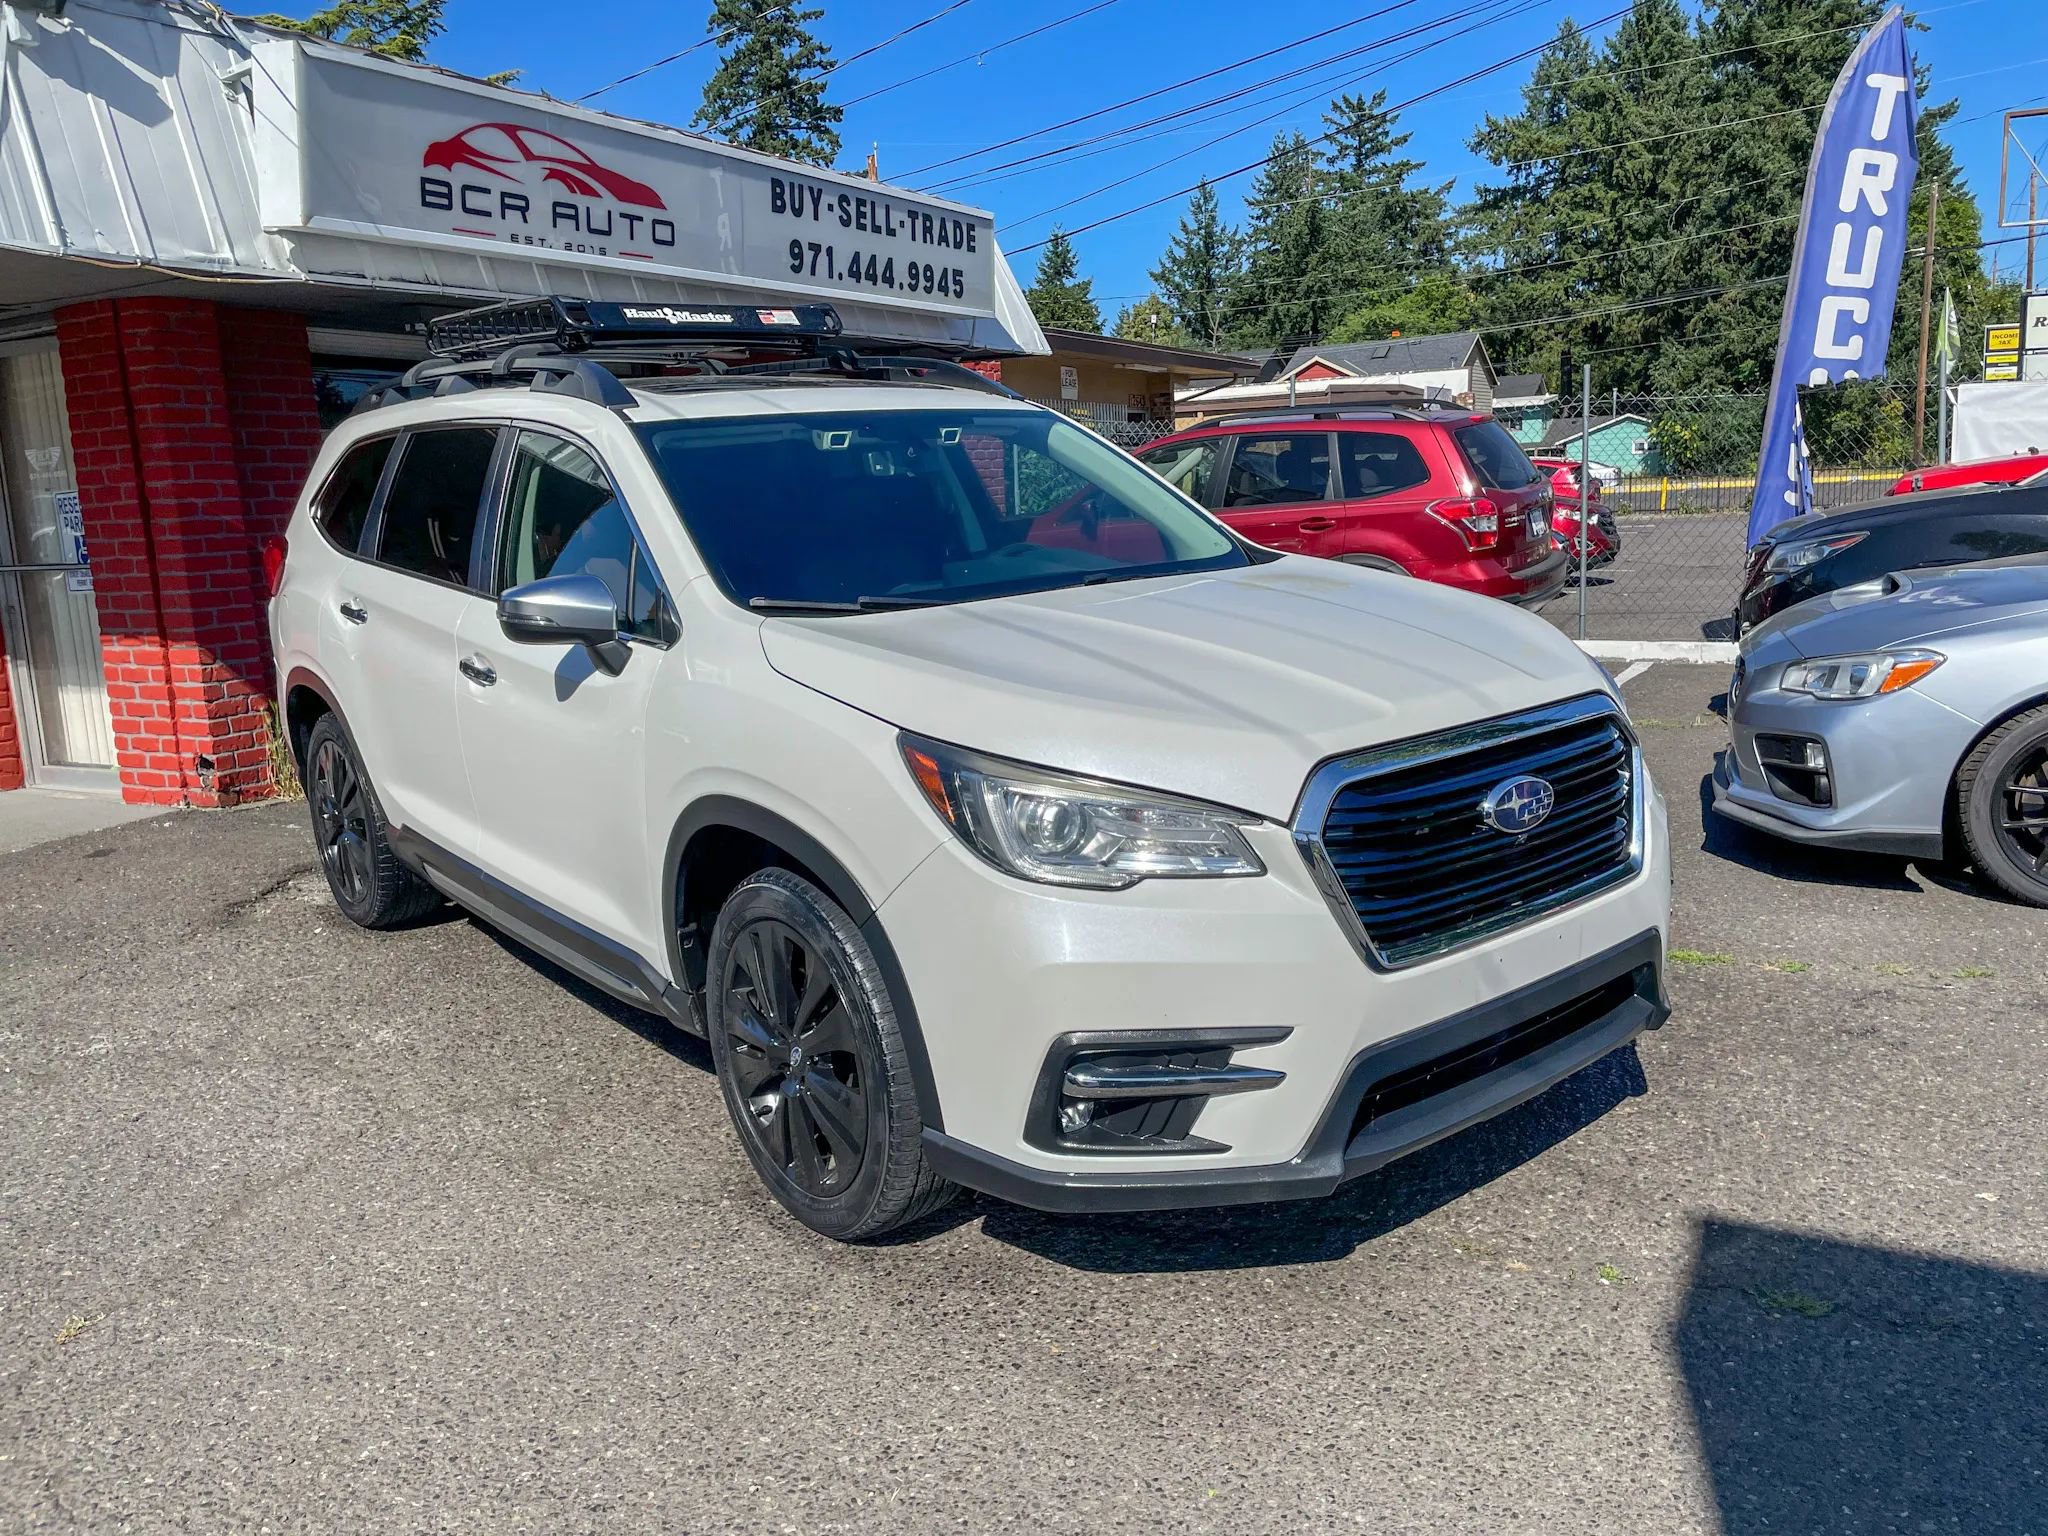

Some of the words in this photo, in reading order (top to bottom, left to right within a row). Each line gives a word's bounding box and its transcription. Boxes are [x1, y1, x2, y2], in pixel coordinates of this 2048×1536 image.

[420, 176, 530, 224] BCR
[552, 201, 675, 247] AUTO
[510, 233, 553, 249] EST.
[564, 242, 607, 256] 2015
[789, 238, 964, 299] 971.444.9945
[623, 307, 664, 319] Haul
[673, 310, 734, 323] Master
[2032, 316, 2048, 328] R
[1065, 369, 1074, 377] FOR
[1062, 377, 1077, 387] LEASE
[57, 496, 79, 514] RESE
